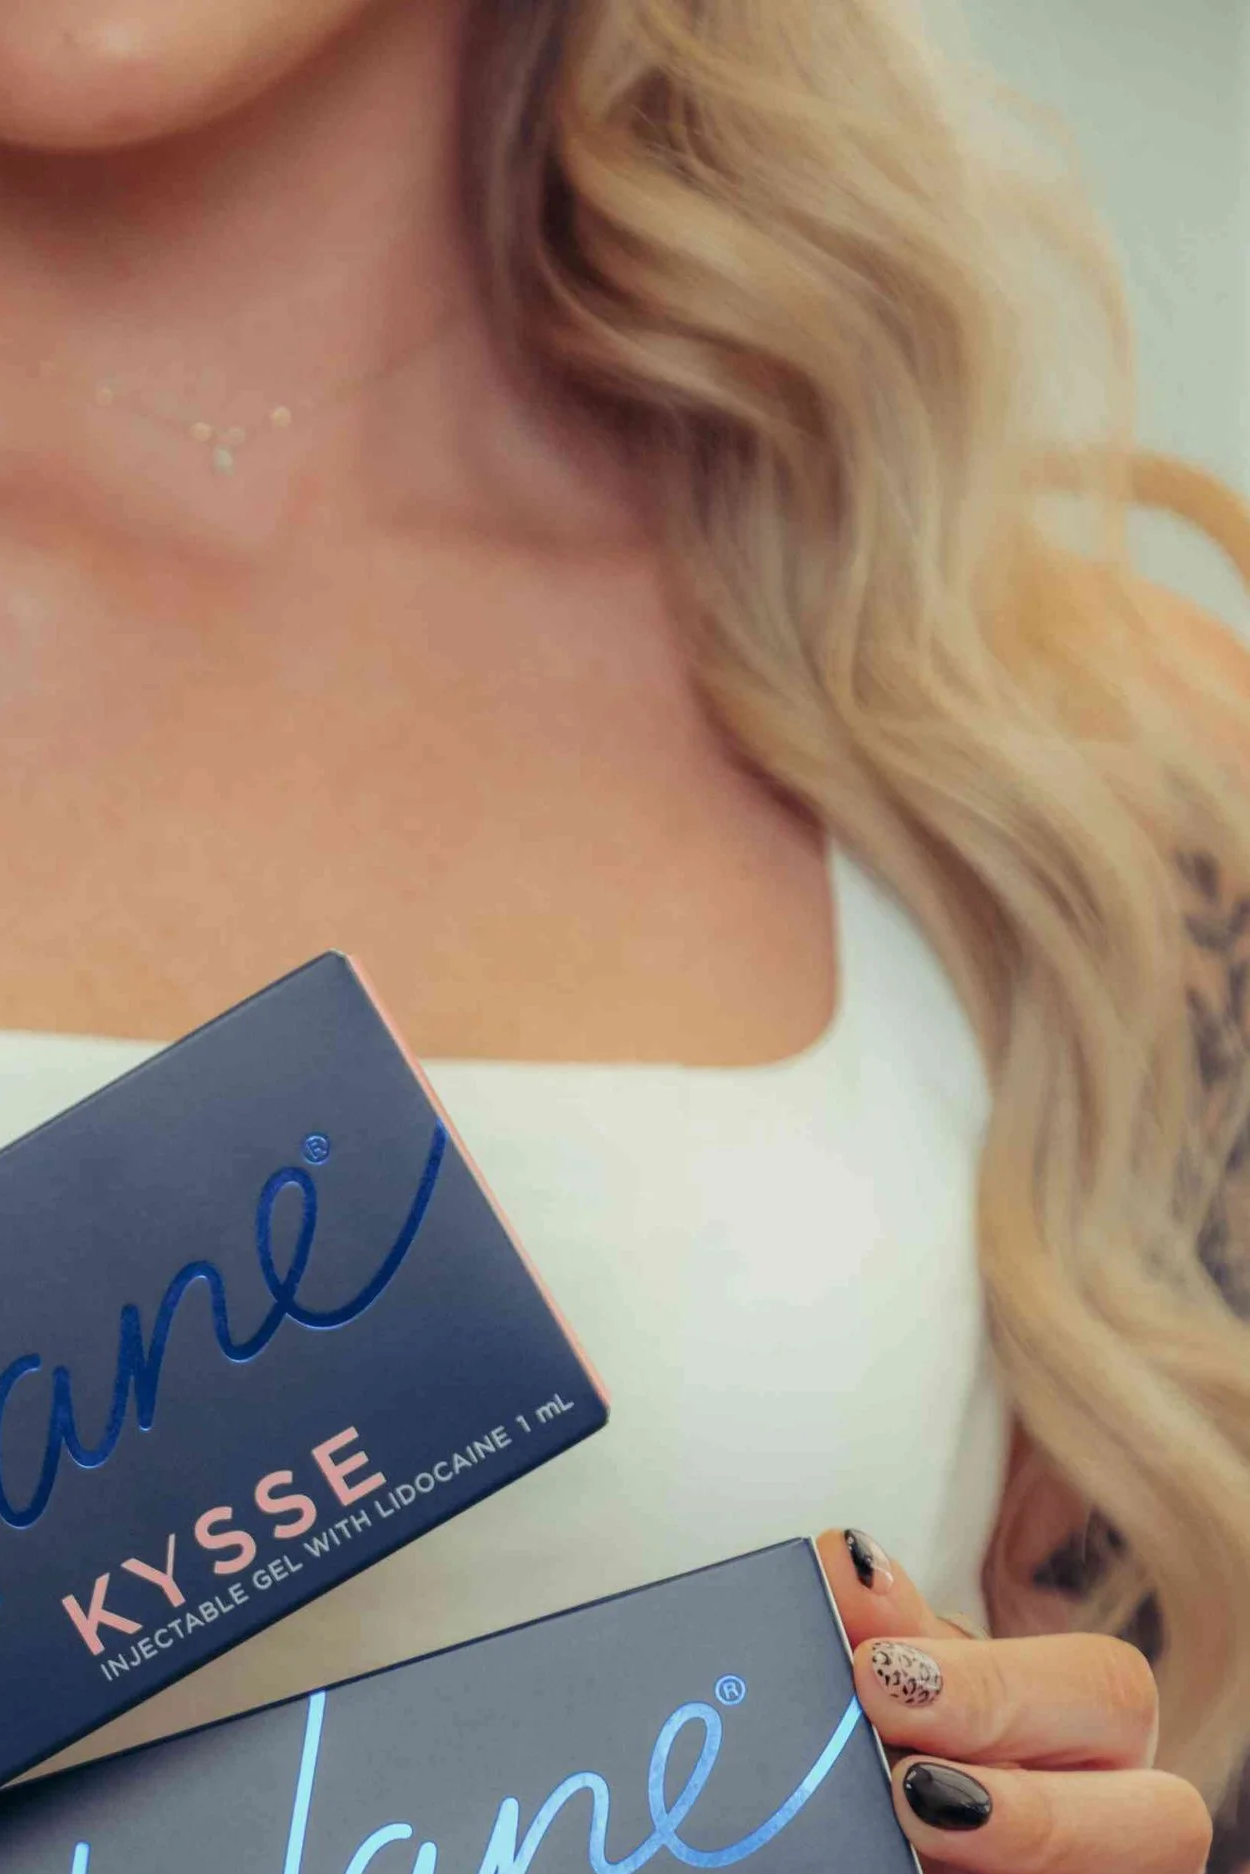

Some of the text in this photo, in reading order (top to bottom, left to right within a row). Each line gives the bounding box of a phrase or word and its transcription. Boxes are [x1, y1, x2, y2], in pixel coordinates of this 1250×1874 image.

[61, 1425, 388, 1656] KYSSE
[100, 1393, 575, 1682] INJECTABLE GEL WITH LIDOCAINE 1 mL
